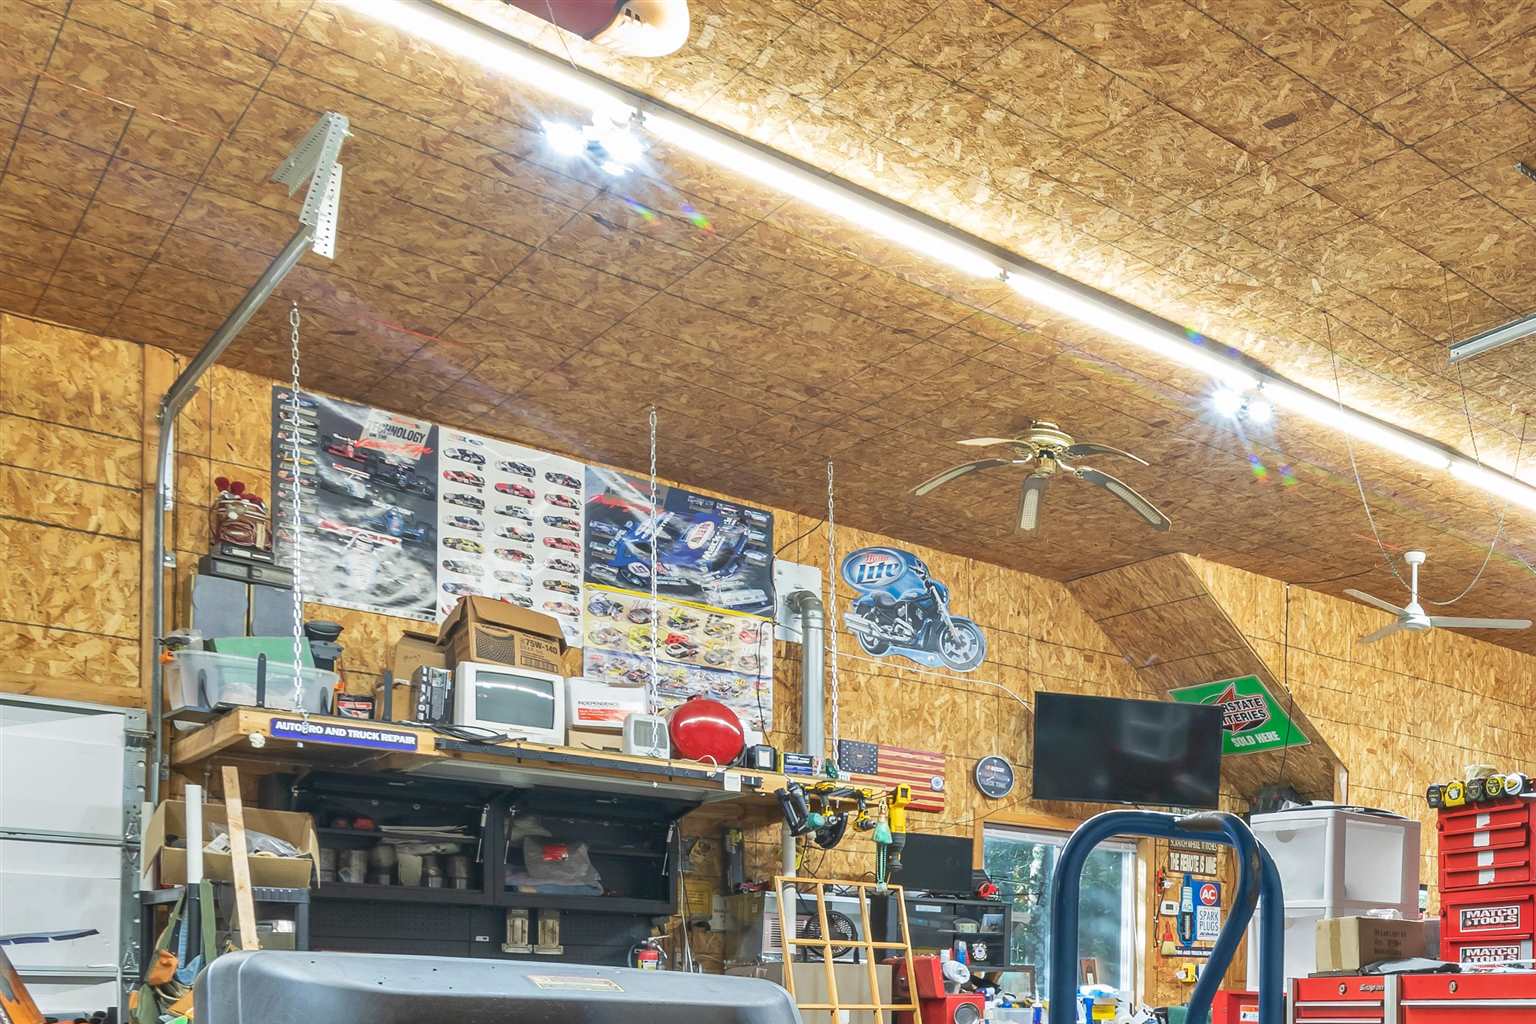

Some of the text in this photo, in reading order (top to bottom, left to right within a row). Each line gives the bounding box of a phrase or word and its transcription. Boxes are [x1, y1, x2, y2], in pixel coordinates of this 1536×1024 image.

[275, 720, 416, 745] AUTORO AND TRUCK REPAIR
[1231, 731, 1281, 748] SOLD HERE
[1202, 890, 1216, 900] AC
[1200, 911, 1219, 920] SPARK
[1466, 909, 1518, 919] MATCO
[1470, 916, 1518, 925] TOOLS
[1200, 921, 1219, 931] PLUGS
[1466, 947, 1518, 957] MATCO
